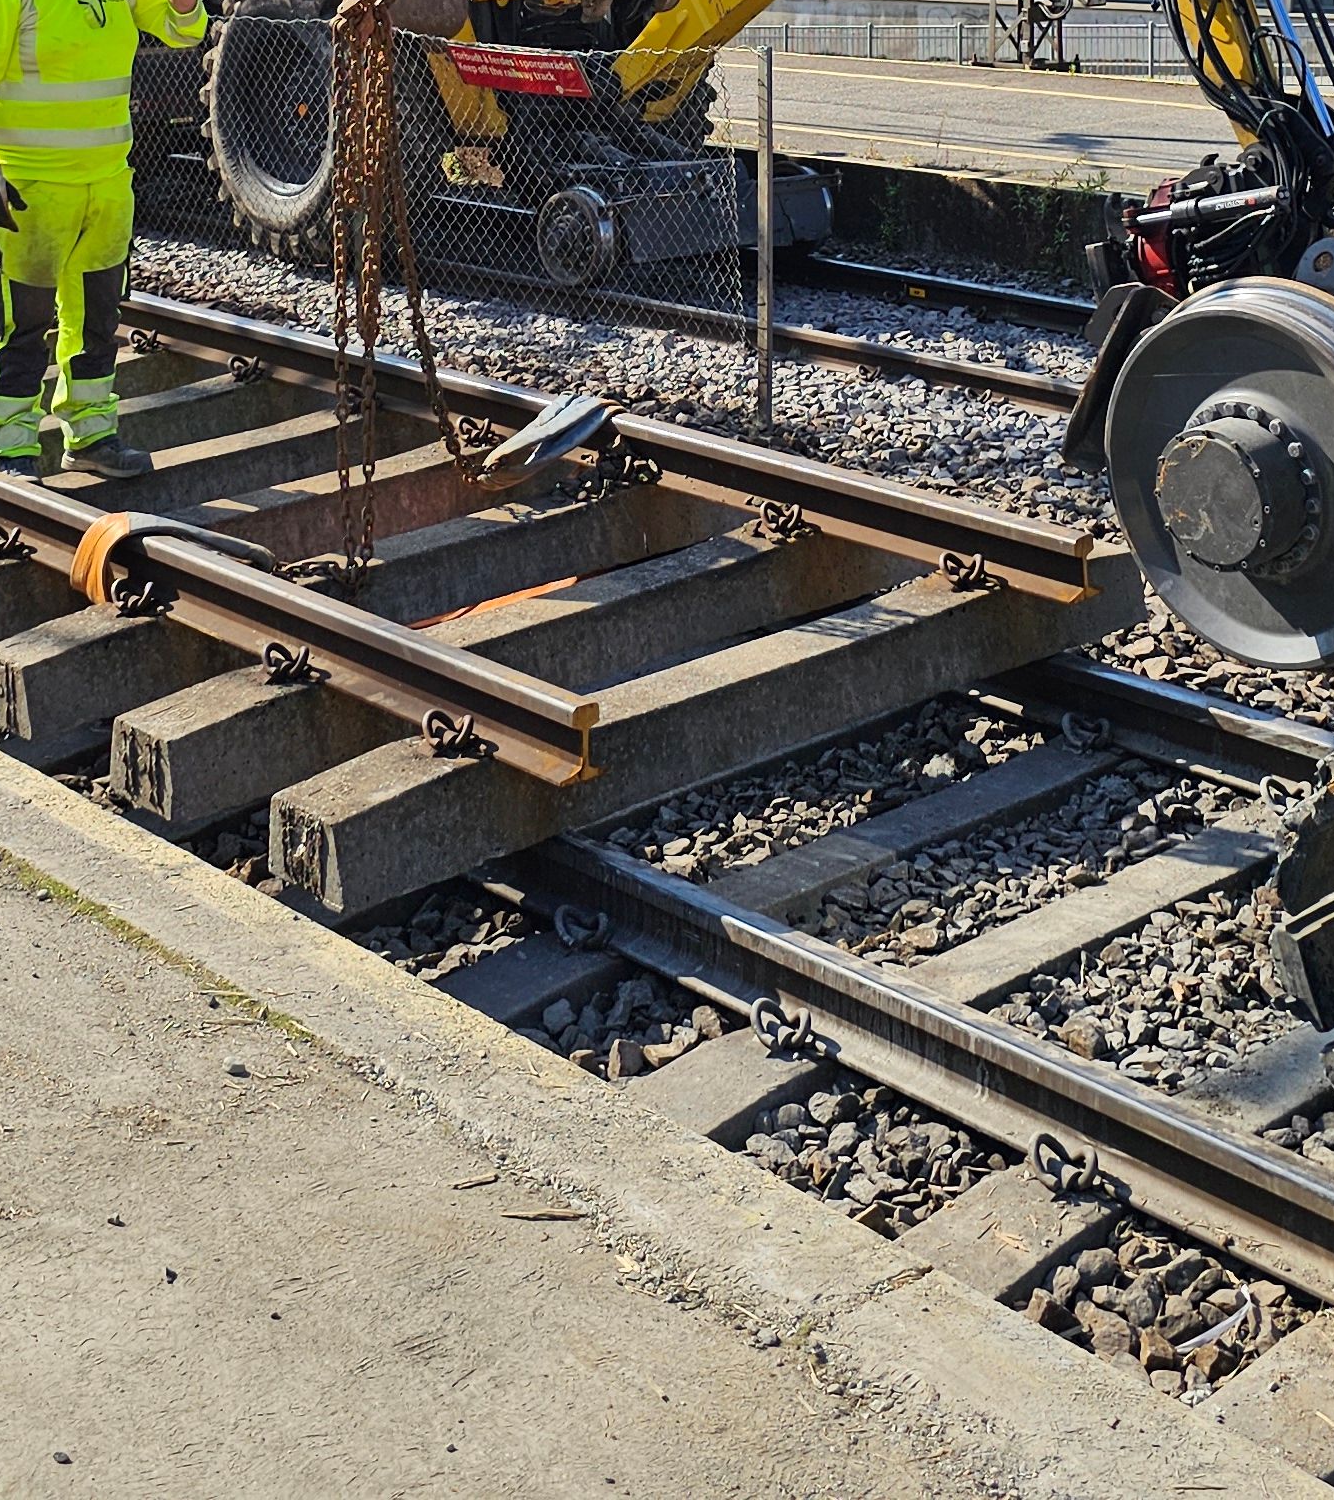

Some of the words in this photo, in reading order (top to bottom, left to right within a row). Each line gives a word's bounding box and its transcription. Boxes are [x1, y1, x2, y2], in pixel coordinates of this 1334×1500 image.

[451, 49, 483, 63] Forbudt
[488, 54, 515, 67] ferdes
[518, 59, 575, 71] sporområdet
[457, 62, 477, 75] Keep
[478, 64, 490, 74] off
[489, 66, 504, 77] the
[503, 68, 534, 81] railway
[533, 71, 557, 81] track
